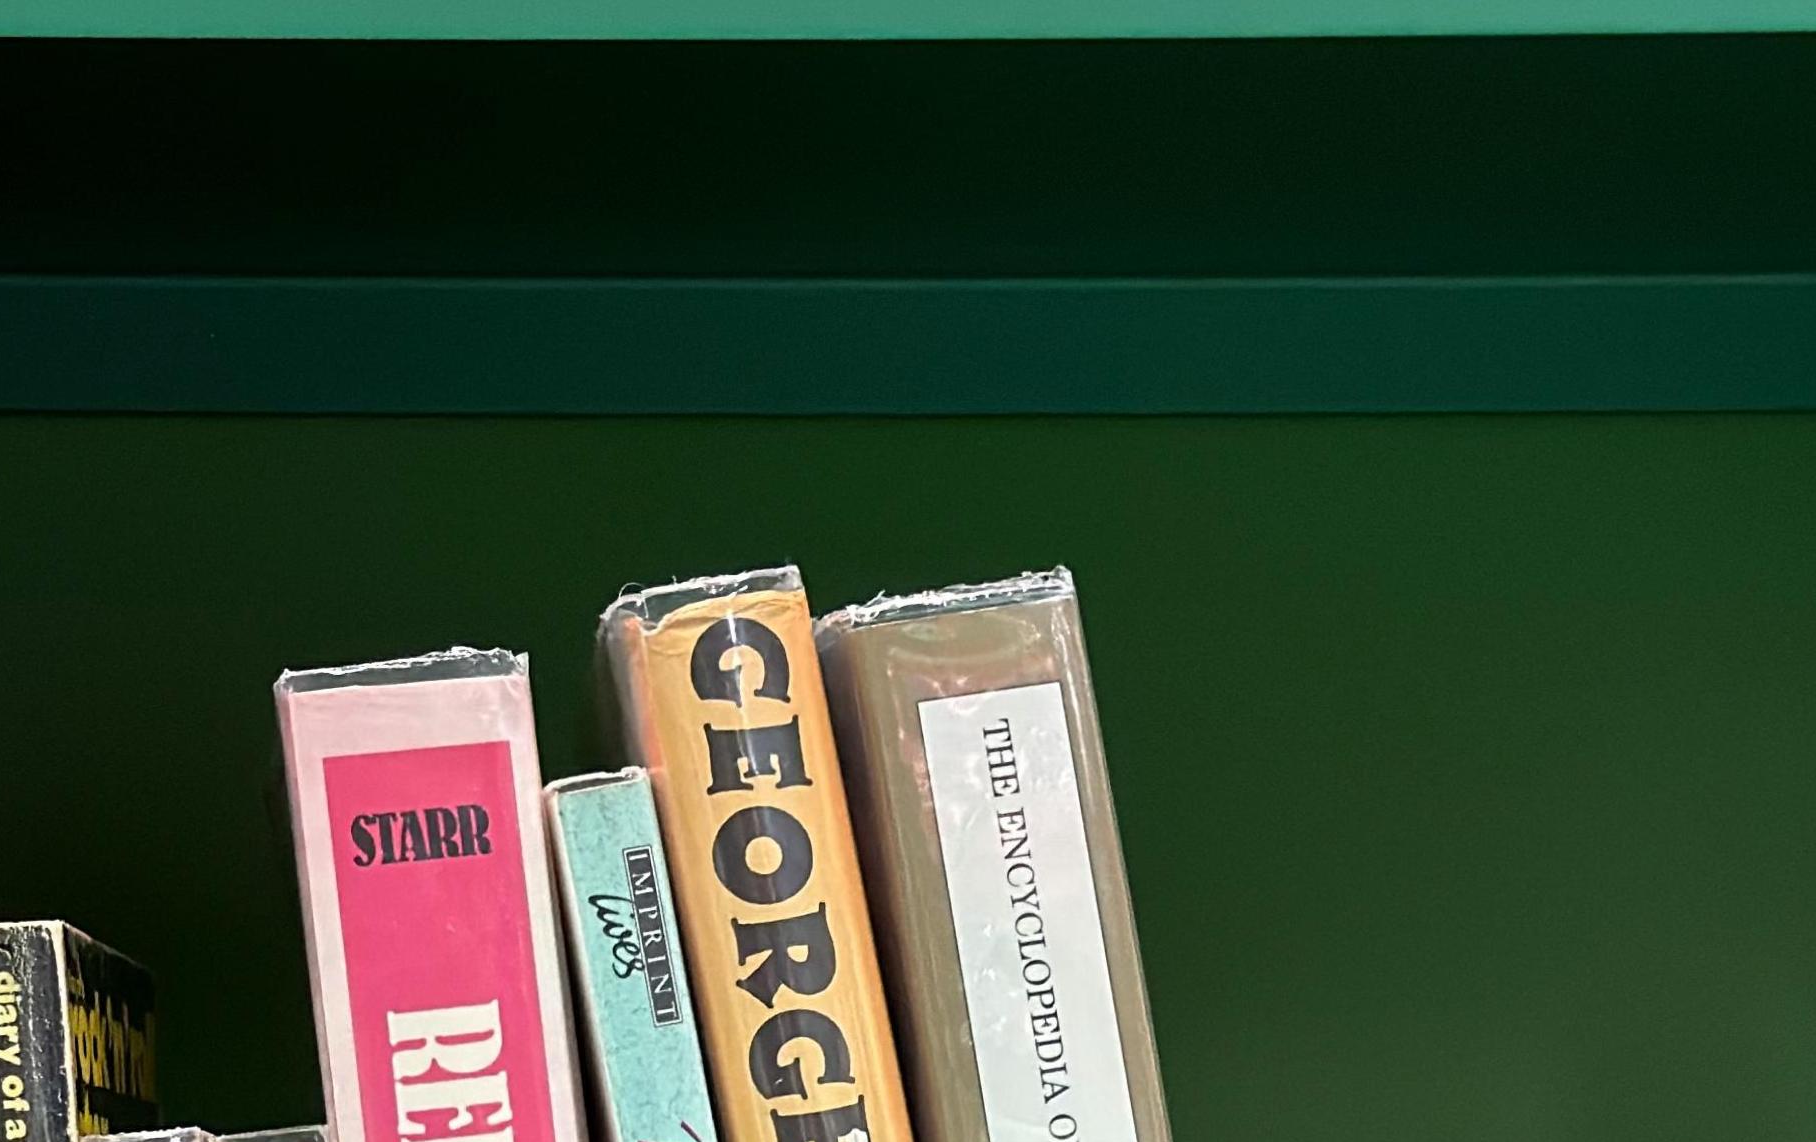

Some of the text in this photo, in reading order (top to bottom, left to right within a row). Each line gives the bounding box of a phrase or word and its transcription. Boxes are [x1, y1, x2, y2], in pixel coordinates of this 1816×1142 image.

[982, 718, 1021, 798] THE
[351, 803, 492, 868] STARR
[627, 851, 678, 1022] IMPRINT
[996, 807, 1071, 1104] ENCYCLOPEDIA
[2, 1073, 30, 1112] of
[7, 1118, 29, 1139] a
